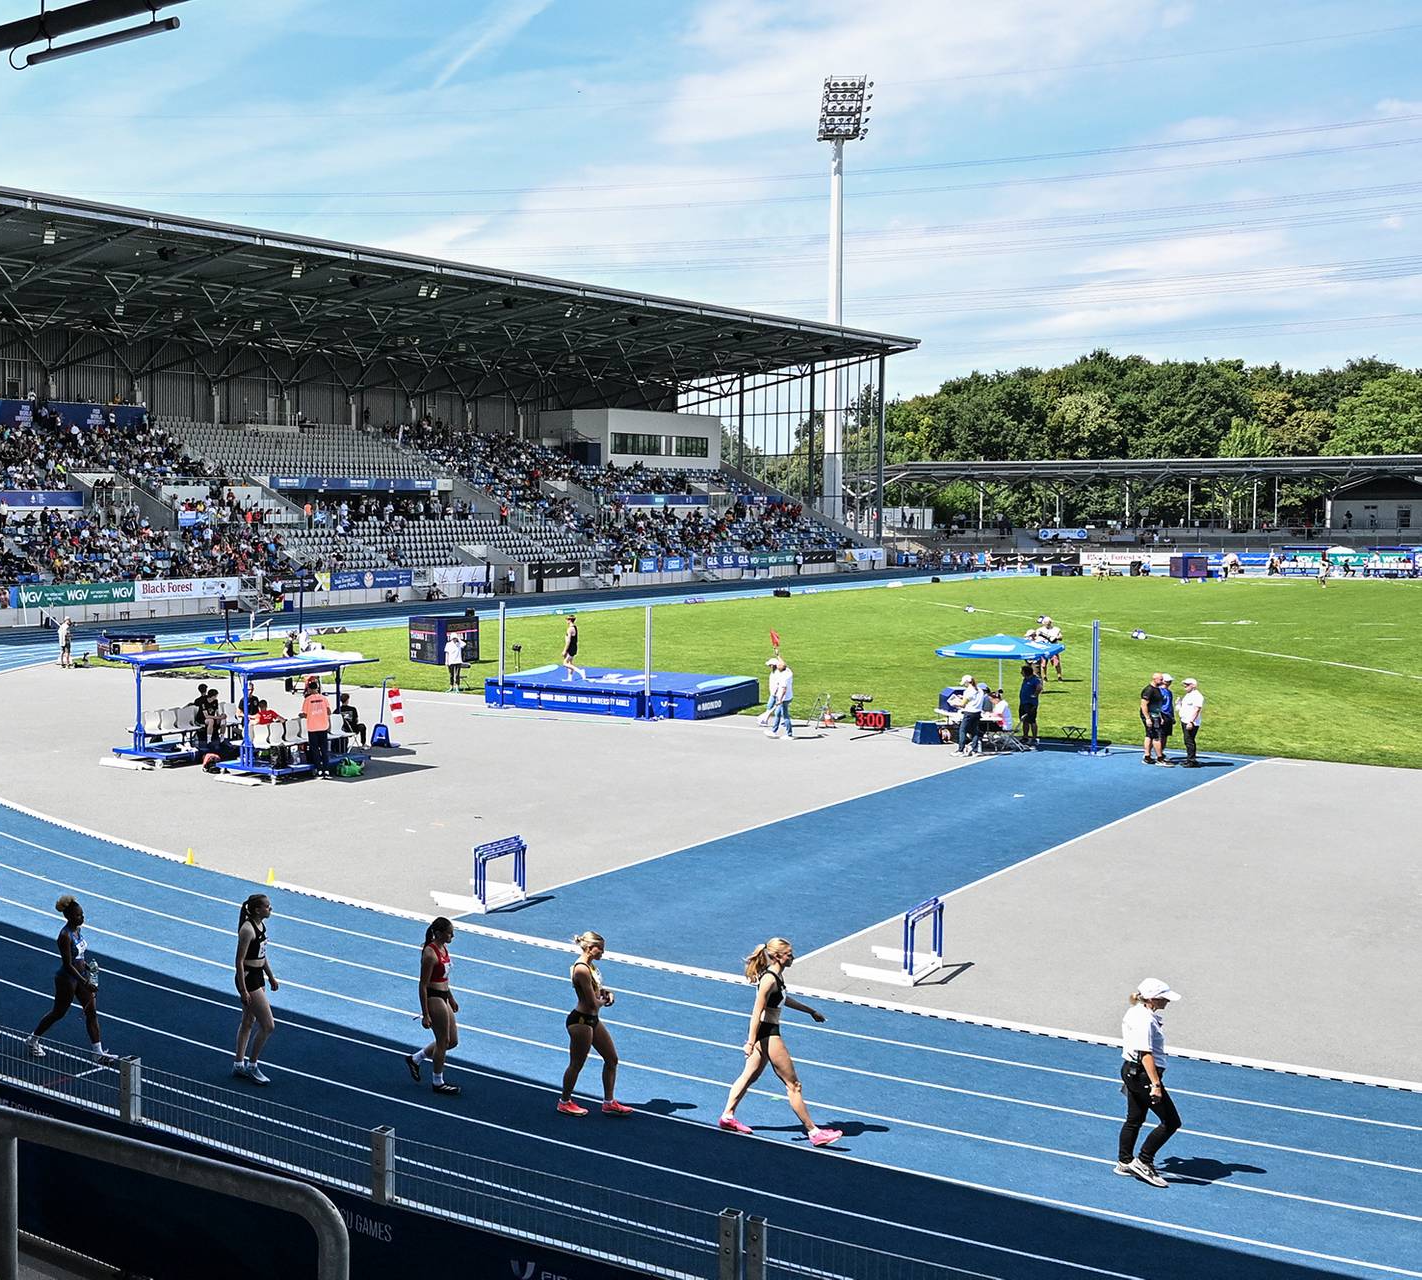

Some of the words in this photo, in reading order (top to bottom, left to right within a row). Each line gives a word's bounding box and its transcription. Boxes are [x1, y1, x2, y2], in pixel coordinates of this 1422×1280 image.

[1337, 555, 1359, 563] WGV
[112, 587, 133, 598] WGV
[142, 582, 166, 594] Black
[167, 582, 193, 593] Forest
[19, 590, 43, 602] WGV
[67, 589, 89, 600] WGV
[592, 697, 615, 705] UNIVERSITY
[616, 699, 630, 707] GAMES
[702, 700, 722, 711] MONDO
[856, 713, 884, 728] 3:00
[355, 1214, 393, 1242] GAMES
